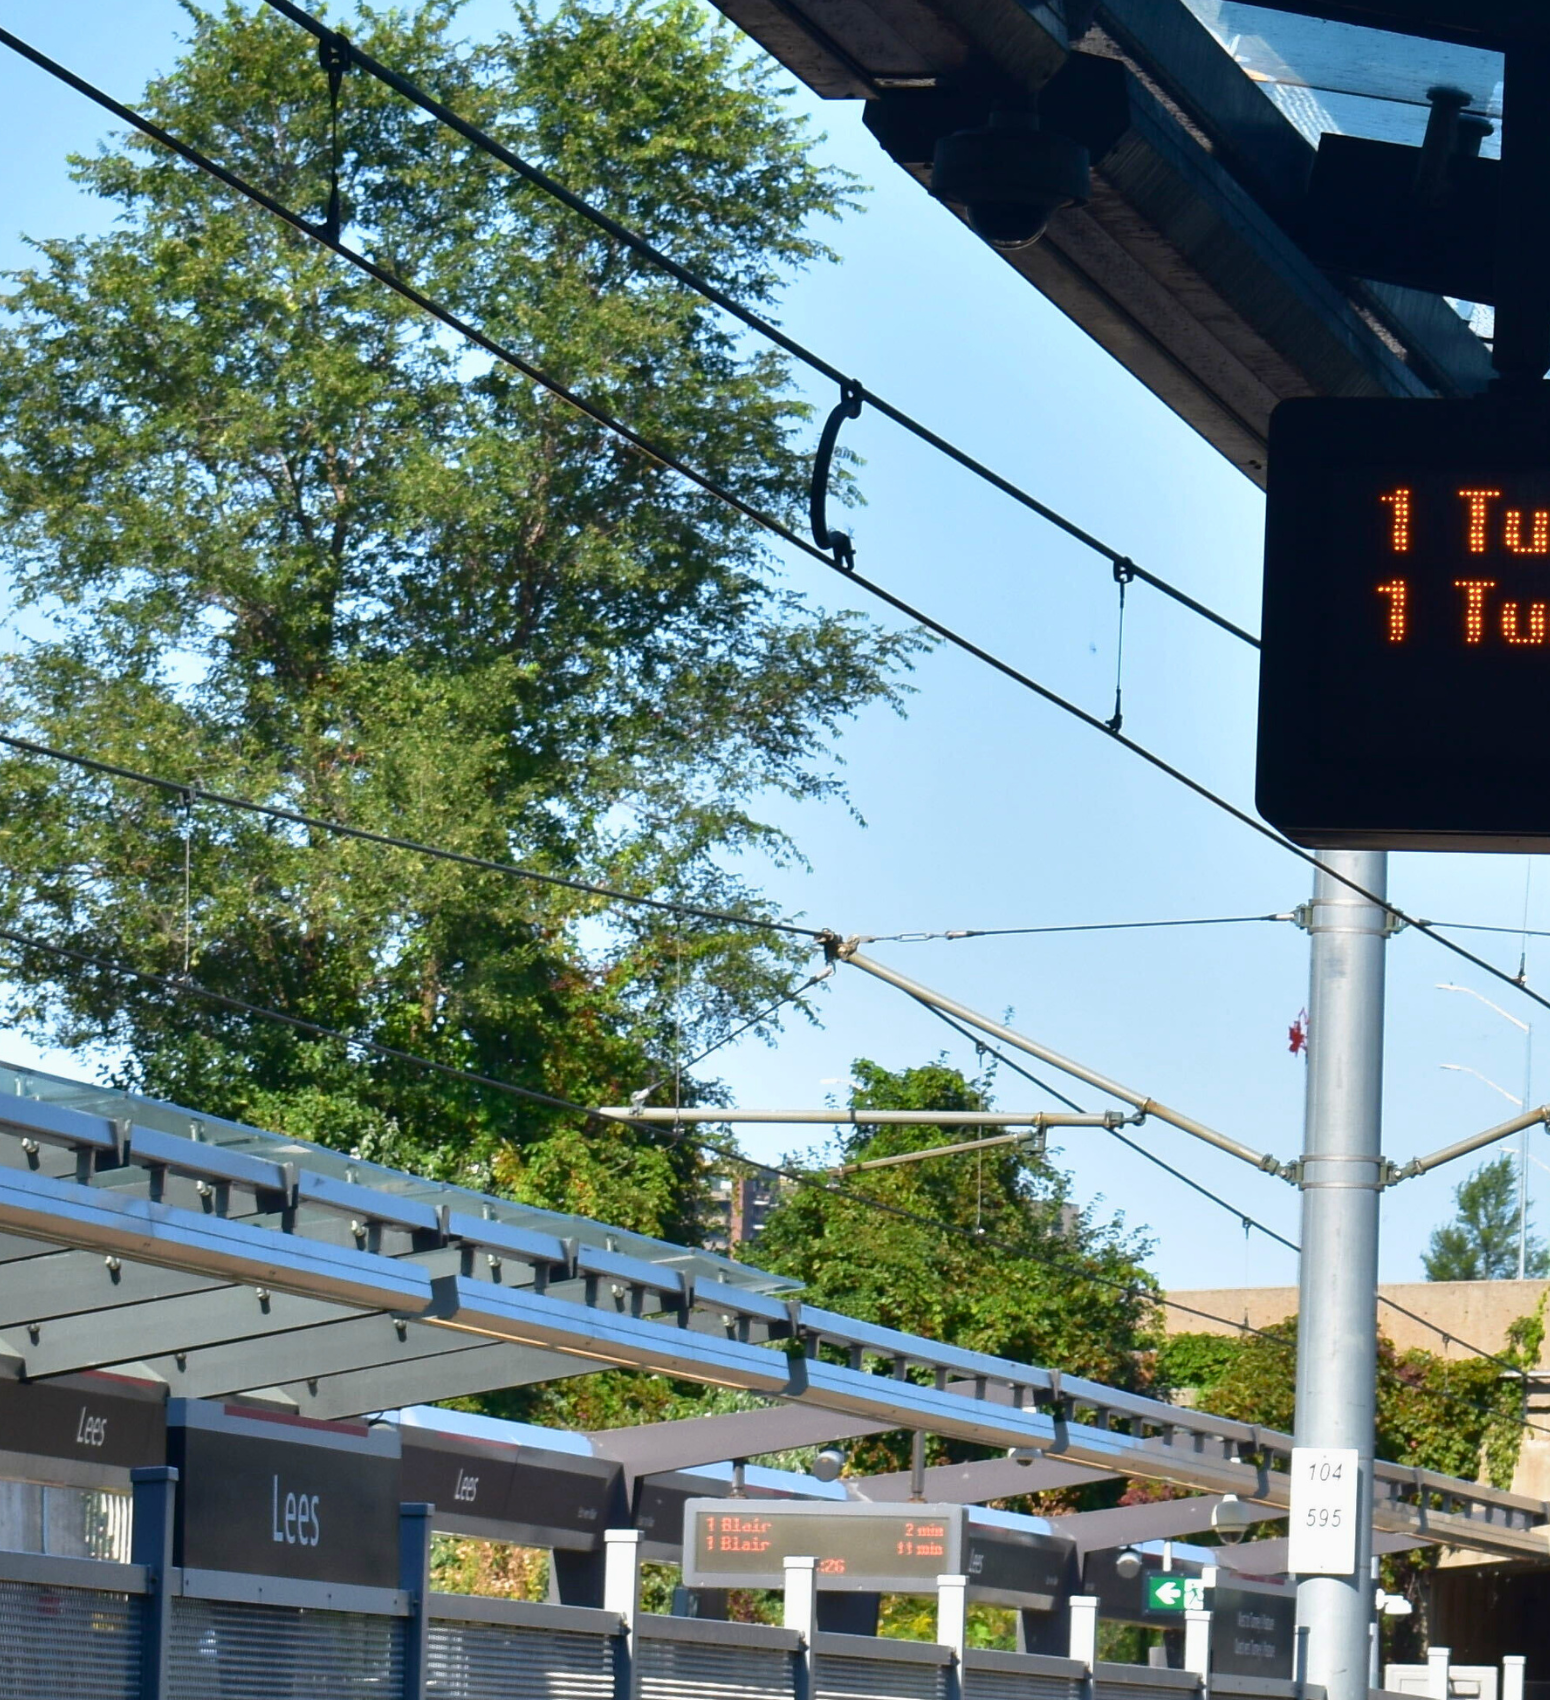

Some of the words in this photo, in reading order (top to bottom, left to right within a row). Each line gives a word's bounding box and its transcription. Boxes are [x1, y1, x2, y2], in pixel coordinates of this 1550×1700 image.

[1380, 488, 1410, 552] 1
[1376, 579, 1408, 642] 1
[76, 1407, 107, 1447] Lees
[454, 1468, 479, 1502] Lees
[1309, 1462, 1343, 1482] 104
[272, 1475, 319, 1547] Lees
[706, 1516, 715, 1533] 1
[720, 1516, 772, 1534] Blair
[905, 1522, 914, 1538] 2
[917, 1523, 945, 1538] min
[1306, 1508, 1342, 1528] 595
[706, 1535, 715, 1552] 1
[720, 1535, 771, 1552] Blair
[897, 1541, 913, 1557] 11
[916, 1542, 944, 1557] min
